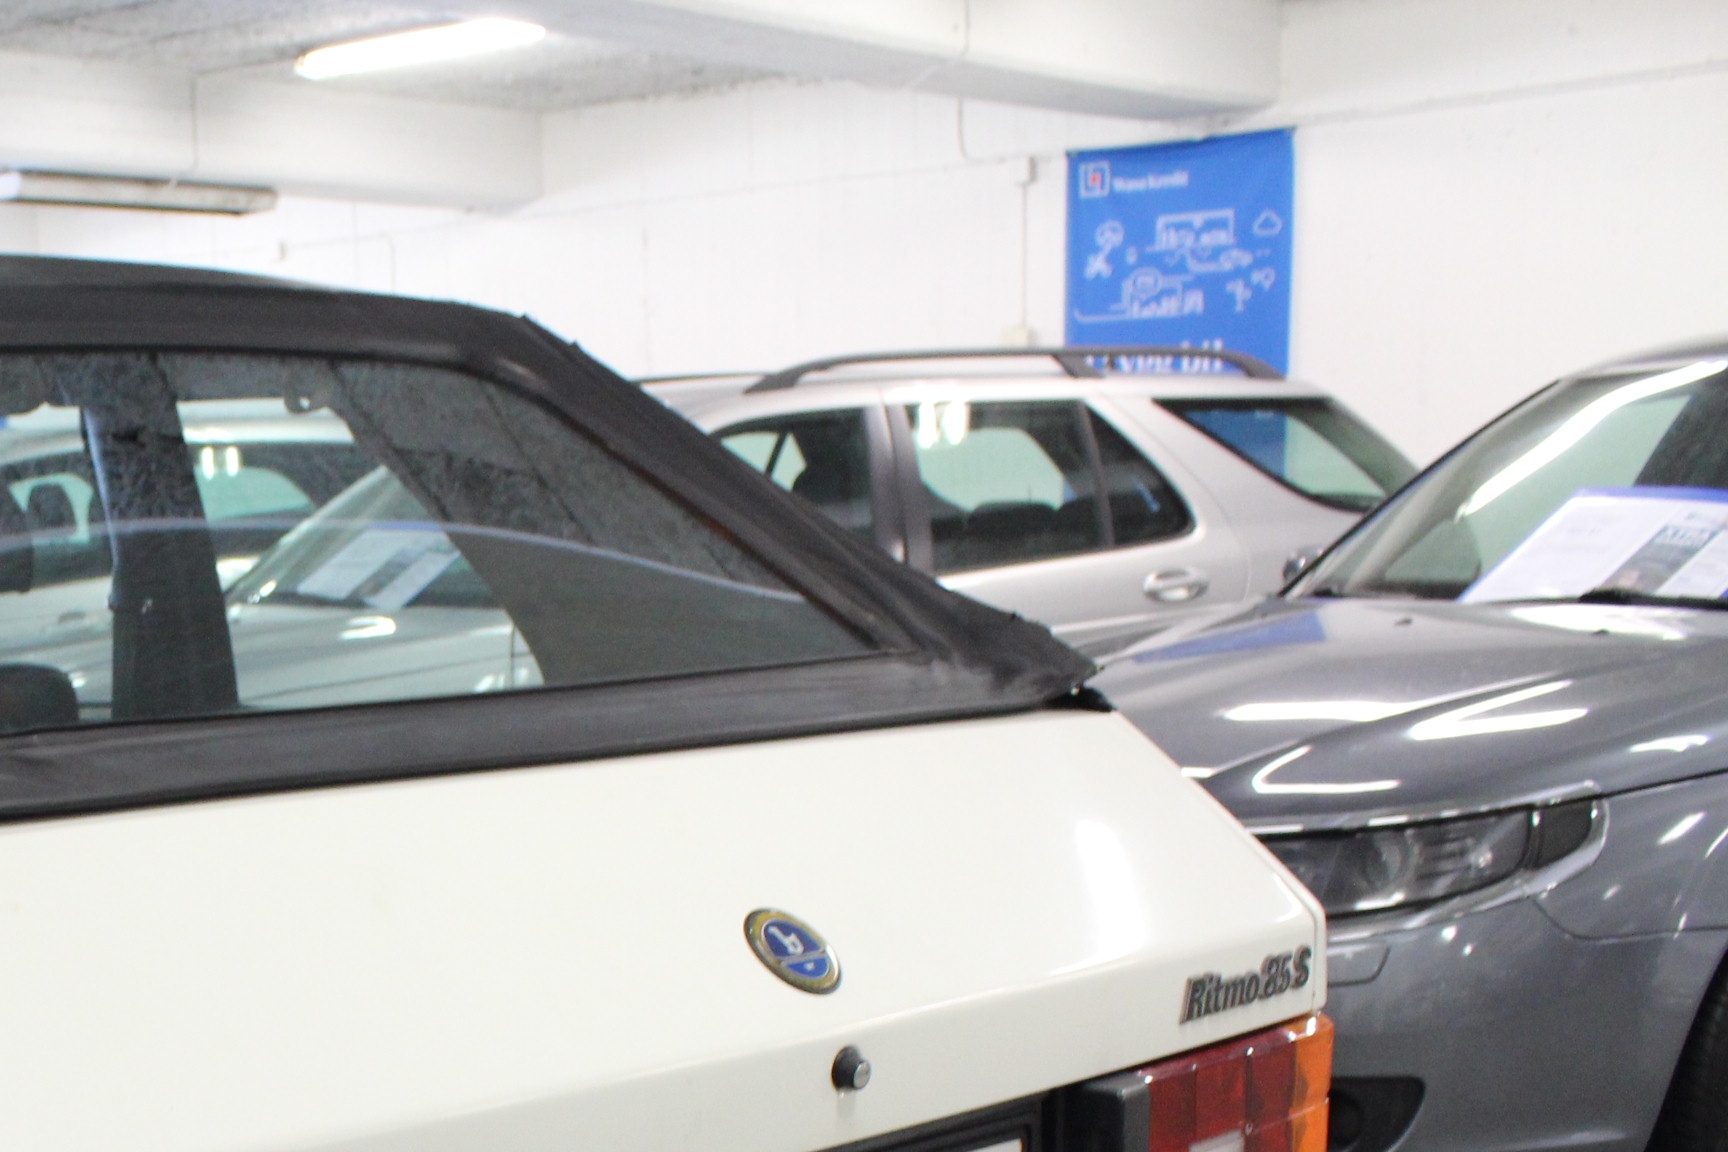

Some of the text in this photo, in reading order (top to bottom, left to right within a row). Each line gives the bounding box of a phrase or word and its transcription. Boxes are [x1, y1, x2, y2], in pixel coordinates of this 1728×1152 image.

[1179, 944, 1312, 1024] Ritmo 85 S
